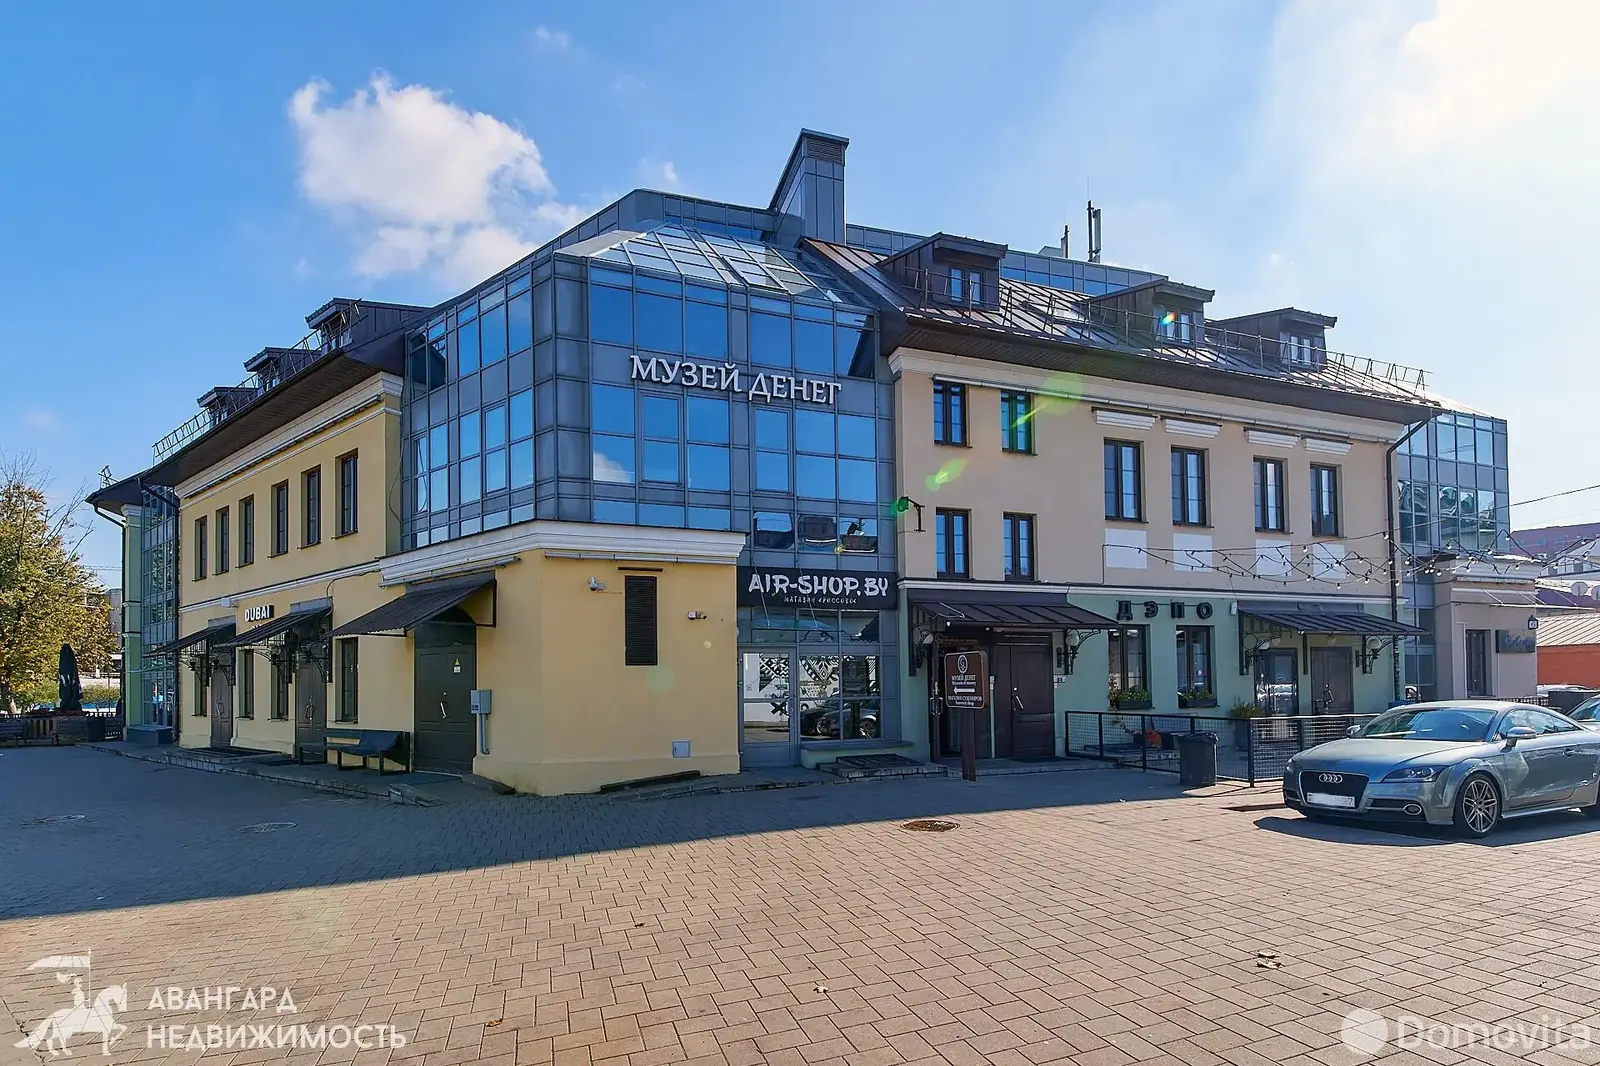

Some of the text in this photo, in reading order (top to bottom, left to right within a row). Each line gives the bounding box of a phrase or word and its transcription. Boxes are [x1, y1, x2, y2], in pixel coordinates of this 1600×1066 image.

[630, 354, 841, 404] МУЗЕЙ ДЕНЕГ
[748, 573, 889, 597] AIR-SHOP.BY
[244, 605, 270, 622] DUBAI
[1116, 599, 1213, 620] ДЭПО
